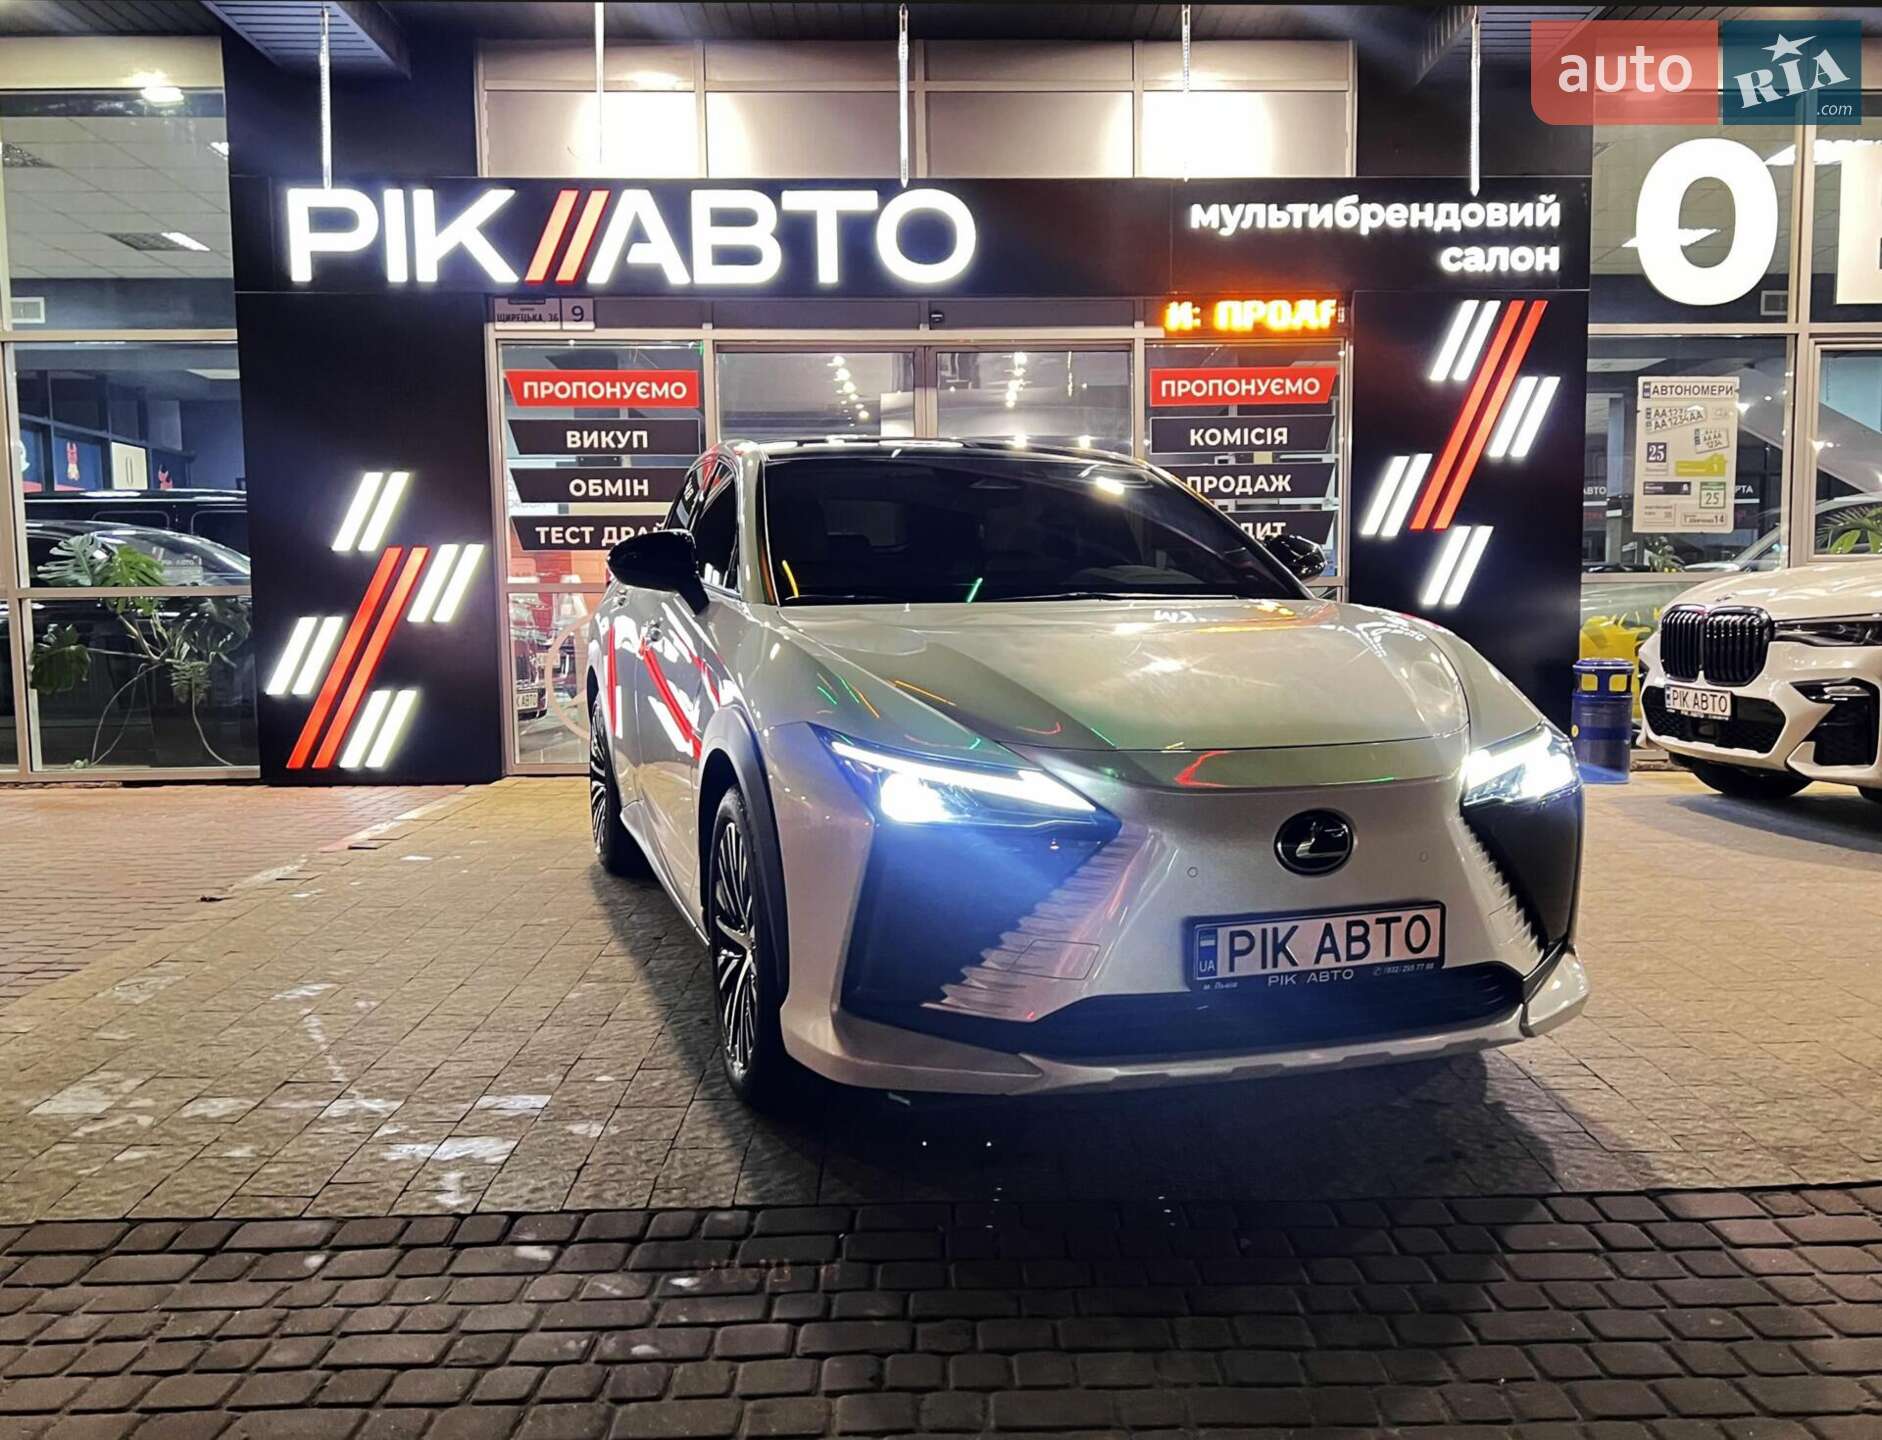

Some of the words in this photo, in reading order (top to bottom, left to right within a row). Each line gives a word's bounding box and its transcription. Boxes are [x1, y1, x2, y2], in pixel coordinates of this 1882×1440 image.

[1190, 194, 1561, 236] мультибрендовий
[1440, 245, 1561, 272] салон
[571, 305, 585, 322] 9
[523, 381, 687, 400] ПРОПОНУЄМО
[1161, 377, 1320, 397] ПРОПОНУЄМО
[1652, 385, 1734, 396] АВТОНОМЕРИ
[566, 430, 648, 449] ВИКУП
[1190, 427, 1289, 446] КОМІСІЯ
[1648, 445, 1665, 461] 25
[569, 479, 649, 497] ОБМІН
[1186, 474, 1292, 495] ПРОДАЖ
[1705, 492, 1720, 505] 25
[1714, 514, 1724, 523] 14
[536, 527, 595, 544] ТЕСТ
[1693, 692, 1728, 713] АВТО
[1313, 914, 1432, 965] АВТО
[1199, 960, 1216, 973] UA
[1306, 968, 1354, 984] АВТО
